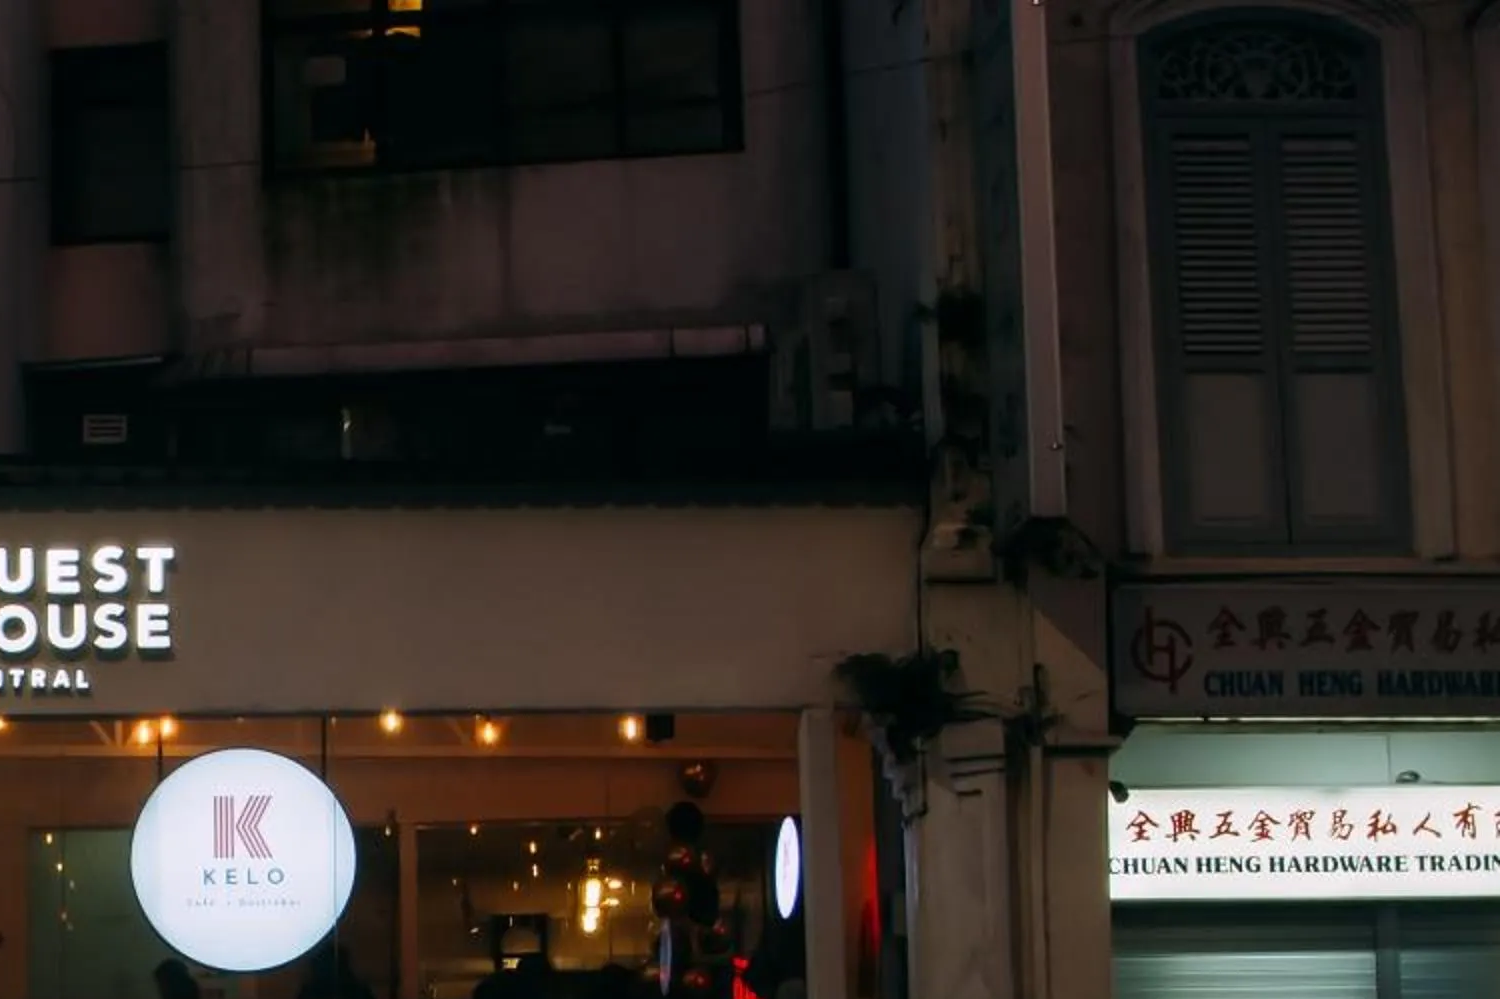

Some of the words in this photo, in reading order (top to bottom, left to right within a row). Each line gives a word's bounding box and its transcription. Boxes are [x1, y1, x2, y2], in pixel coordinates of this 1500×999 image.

[1204, 670, 1284, 698] CHUAN
[1299, 671, 1363, 697] HENG
[1109, 855, 1189, 875] CHUAN
[1196, 855, 1261, 874] HENG
[1269, 855, 1410, 873] HARDWARE
[202, 868, 286, 887] KELO
